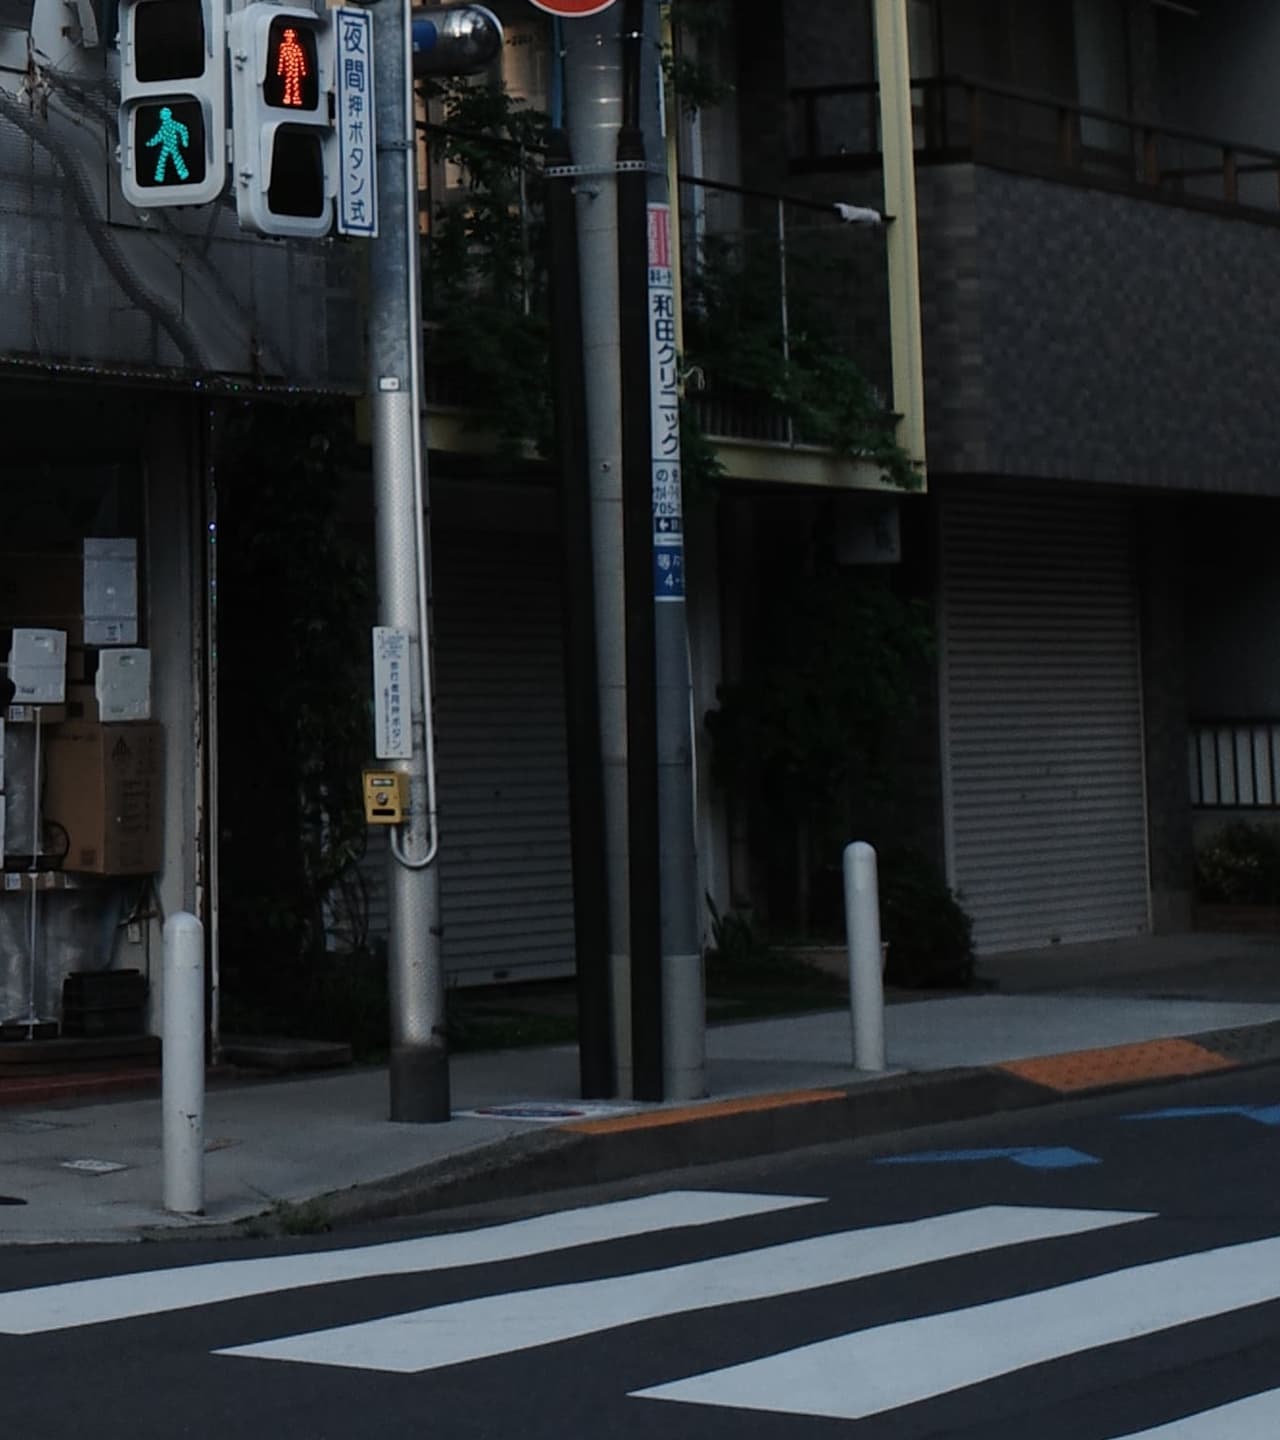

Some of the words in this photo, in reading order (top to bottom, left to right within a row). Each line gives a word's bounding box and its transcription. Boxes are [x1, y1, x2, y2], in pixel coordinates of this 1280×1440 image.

[343, 20, 365, 223] 夜間押ボタン式
